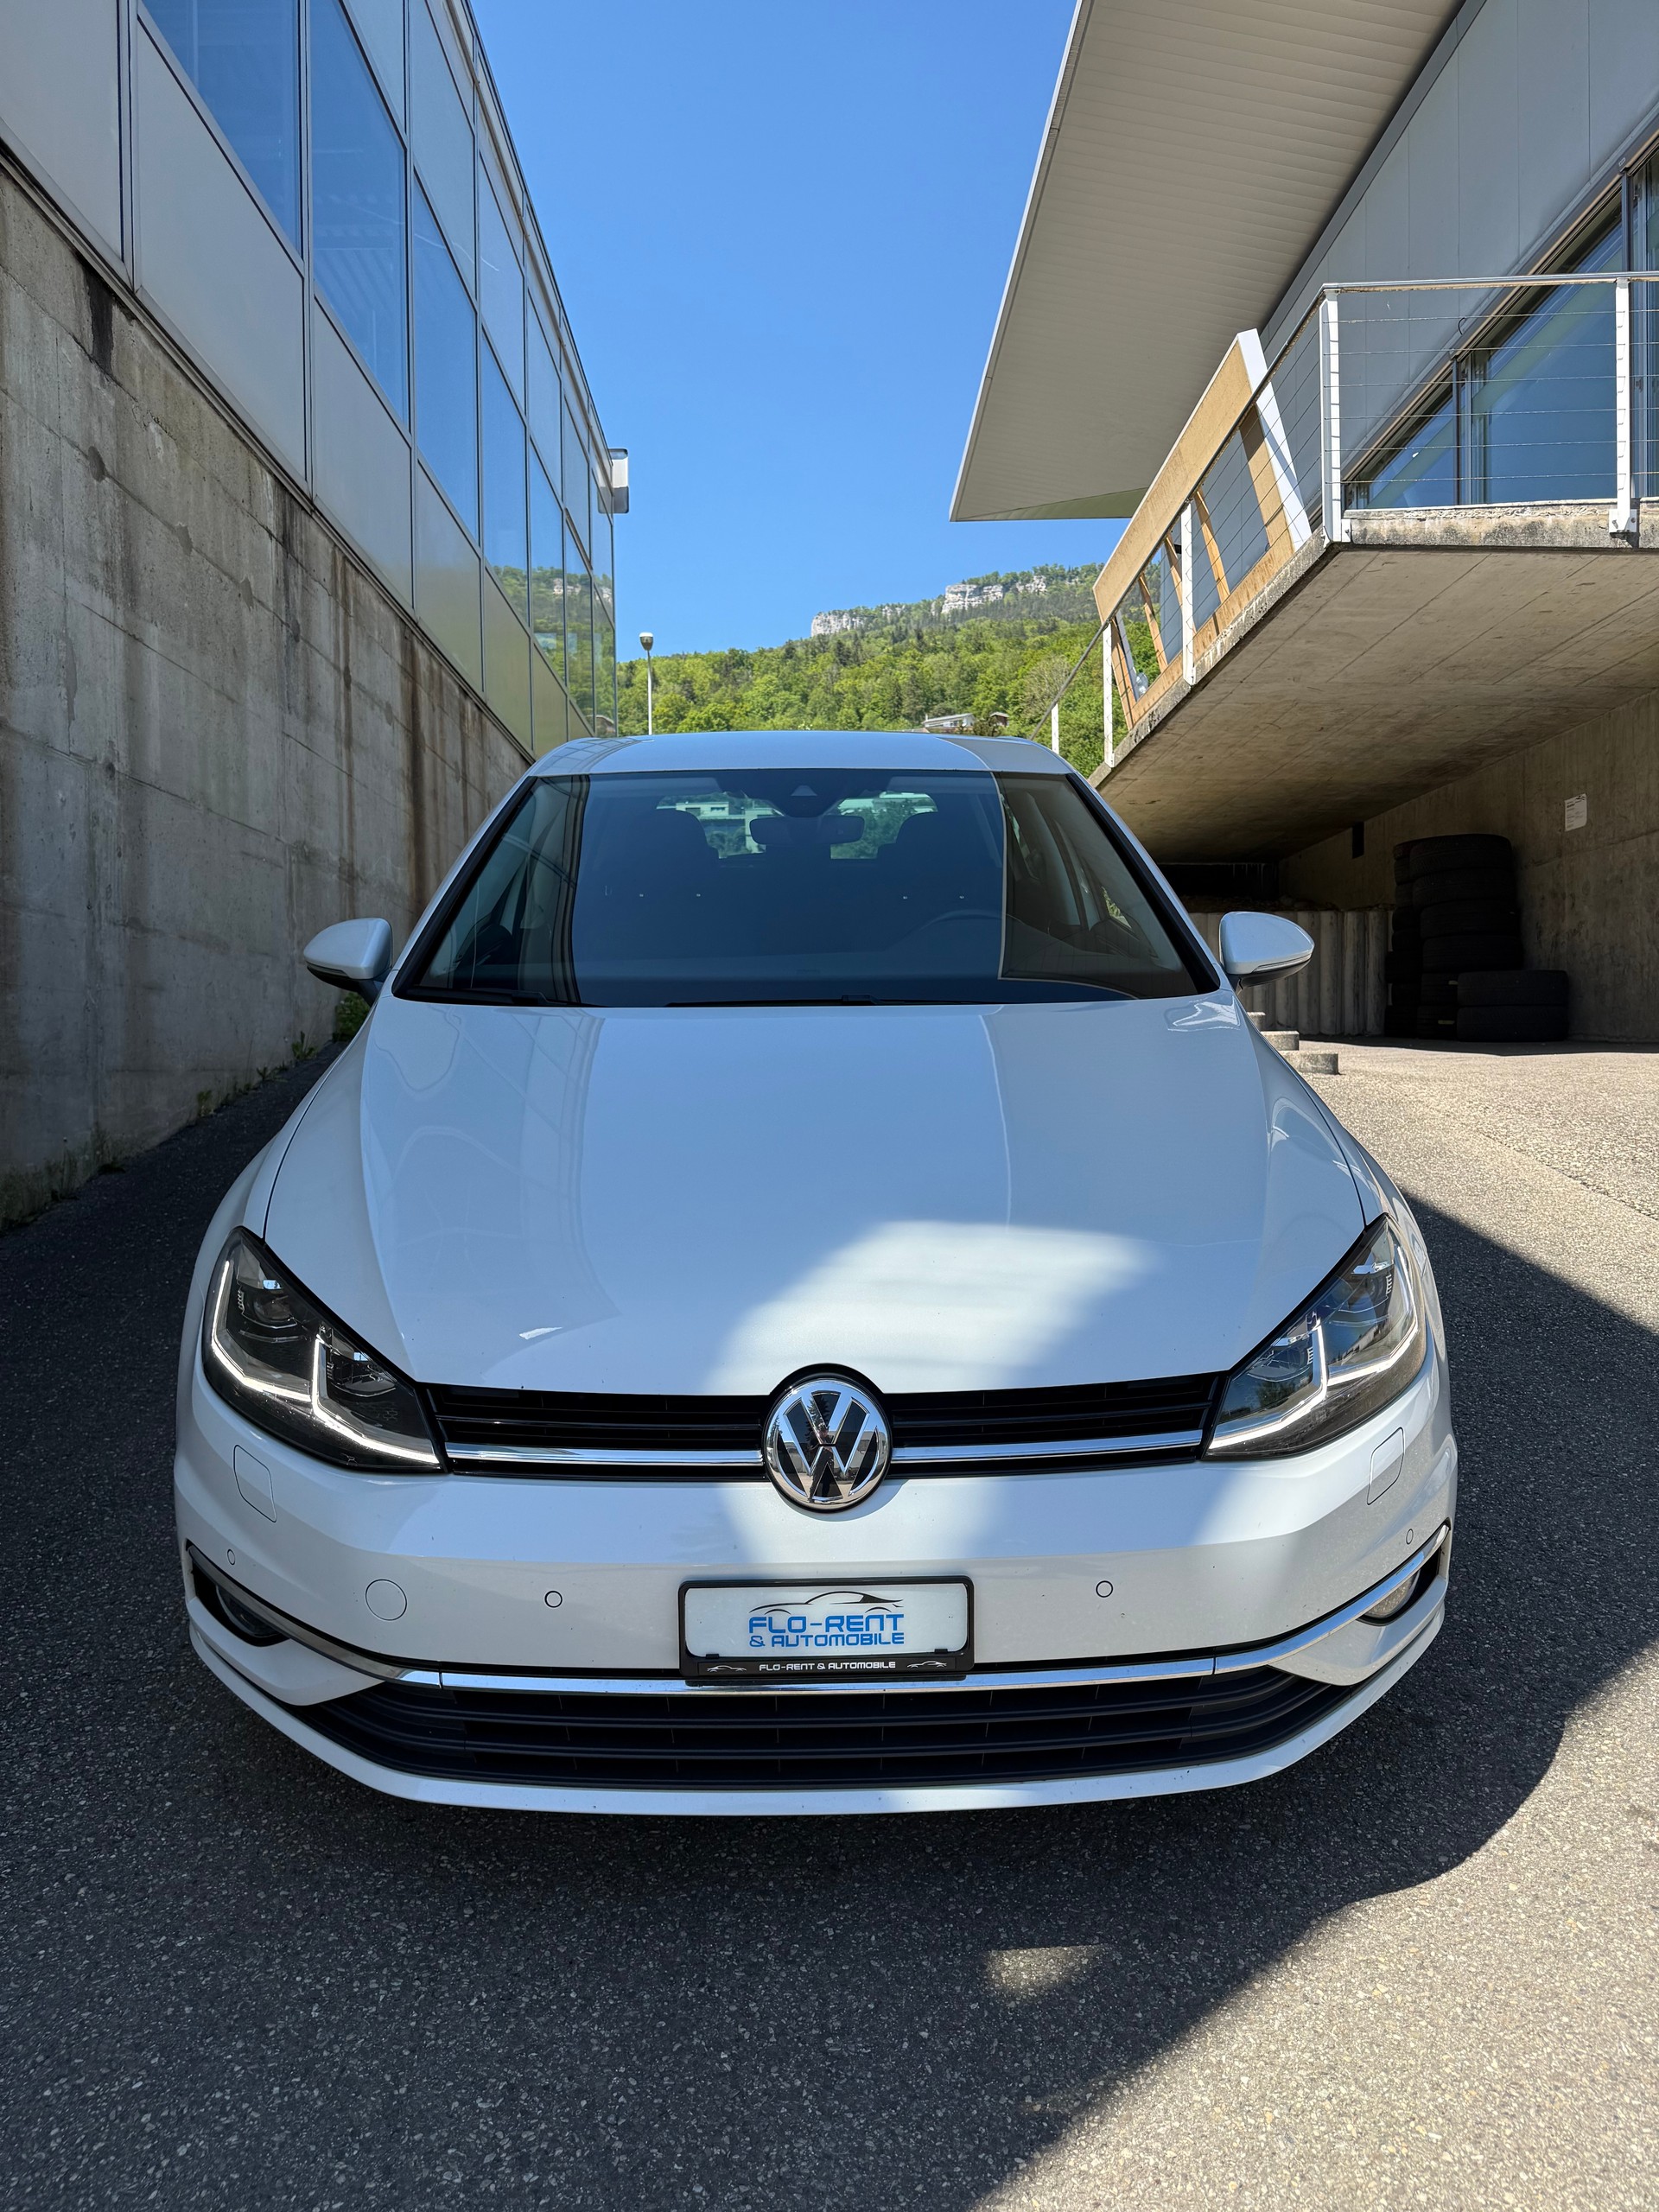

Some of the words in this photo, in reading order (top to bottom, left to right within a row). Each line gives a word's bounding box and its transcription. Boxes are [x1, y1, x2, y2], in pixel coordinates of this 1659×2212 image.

[766, 1379, 891, 1507] VW
[748, 1613, 905, 1634] FLO-RENT
[749, 1636, 766, 1648] &
[771, 1632, 905, 1648] AUTOMOBILE
[759, 1662, 815, 1671] FLO-RENT
[828, 1661, 896, 1670] AUTOMOBILE
